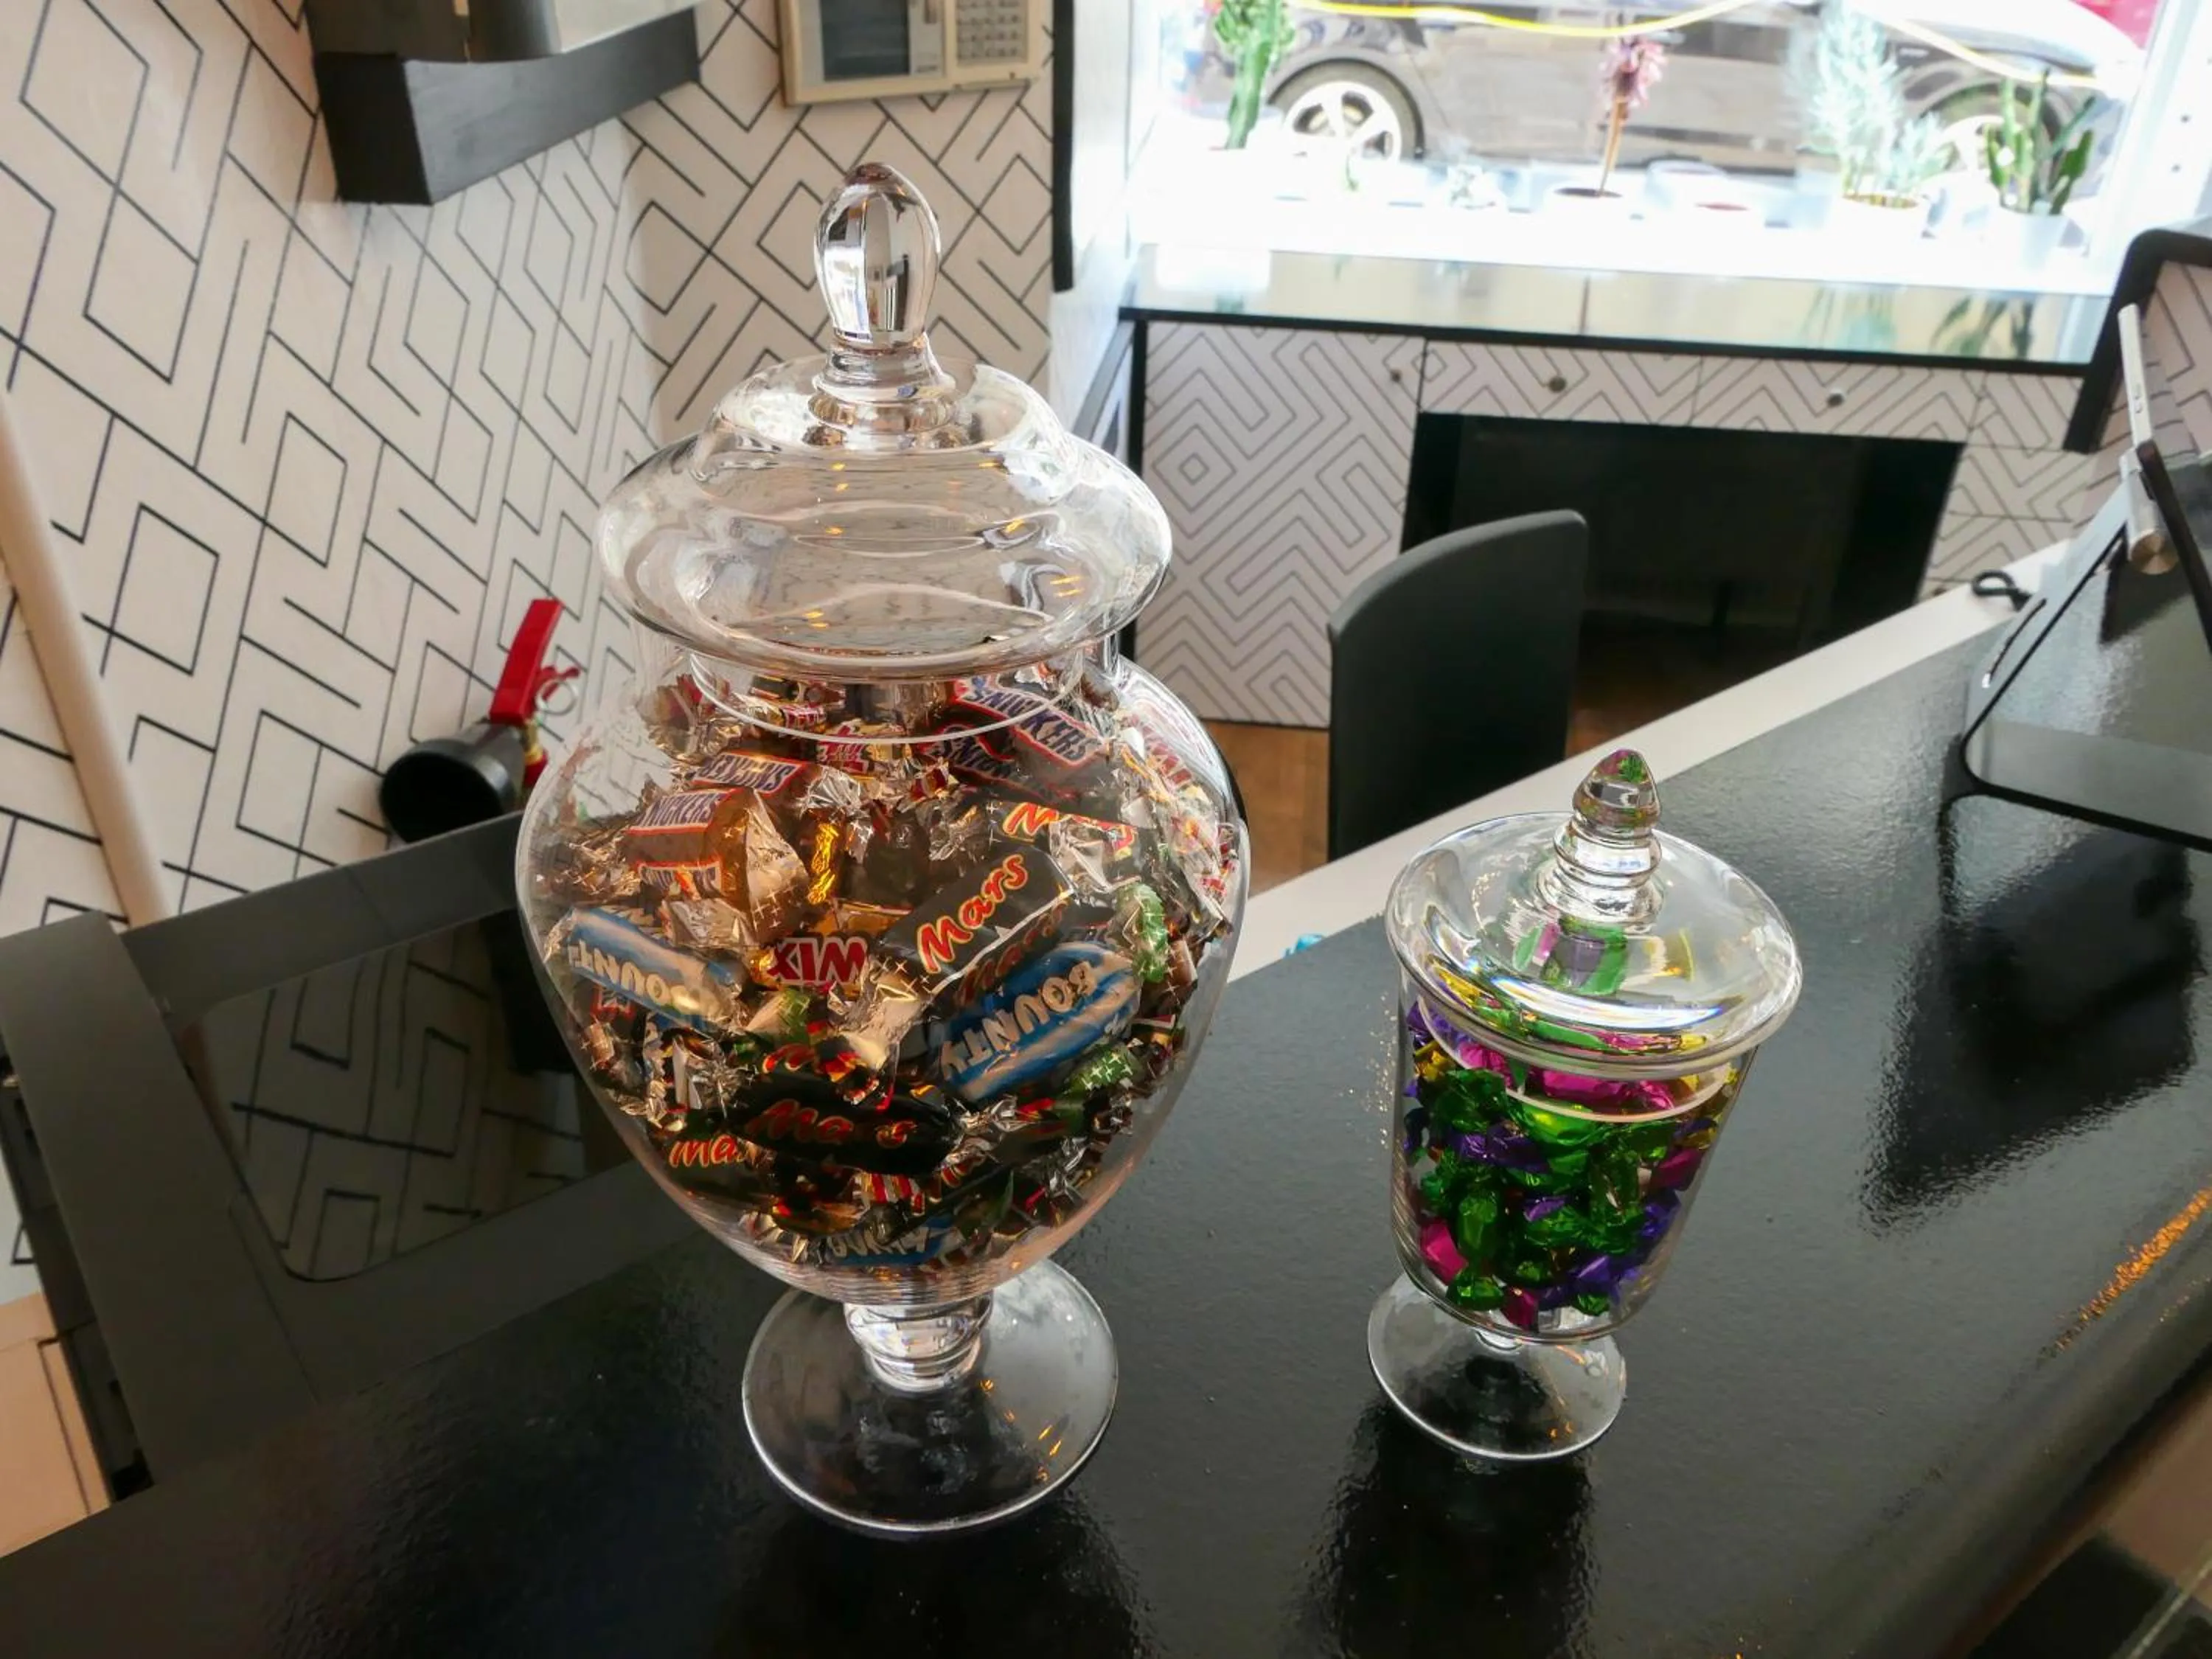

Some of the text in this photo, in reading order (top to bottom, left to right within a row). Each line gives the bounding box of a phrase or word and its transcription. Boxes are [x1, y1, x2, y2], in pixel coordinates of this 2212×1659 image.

[767, 937, 868, 985] WIX
[917, 854, 1029, 974] Mars
[940, 961, 1097, 1080] BOUNTY
